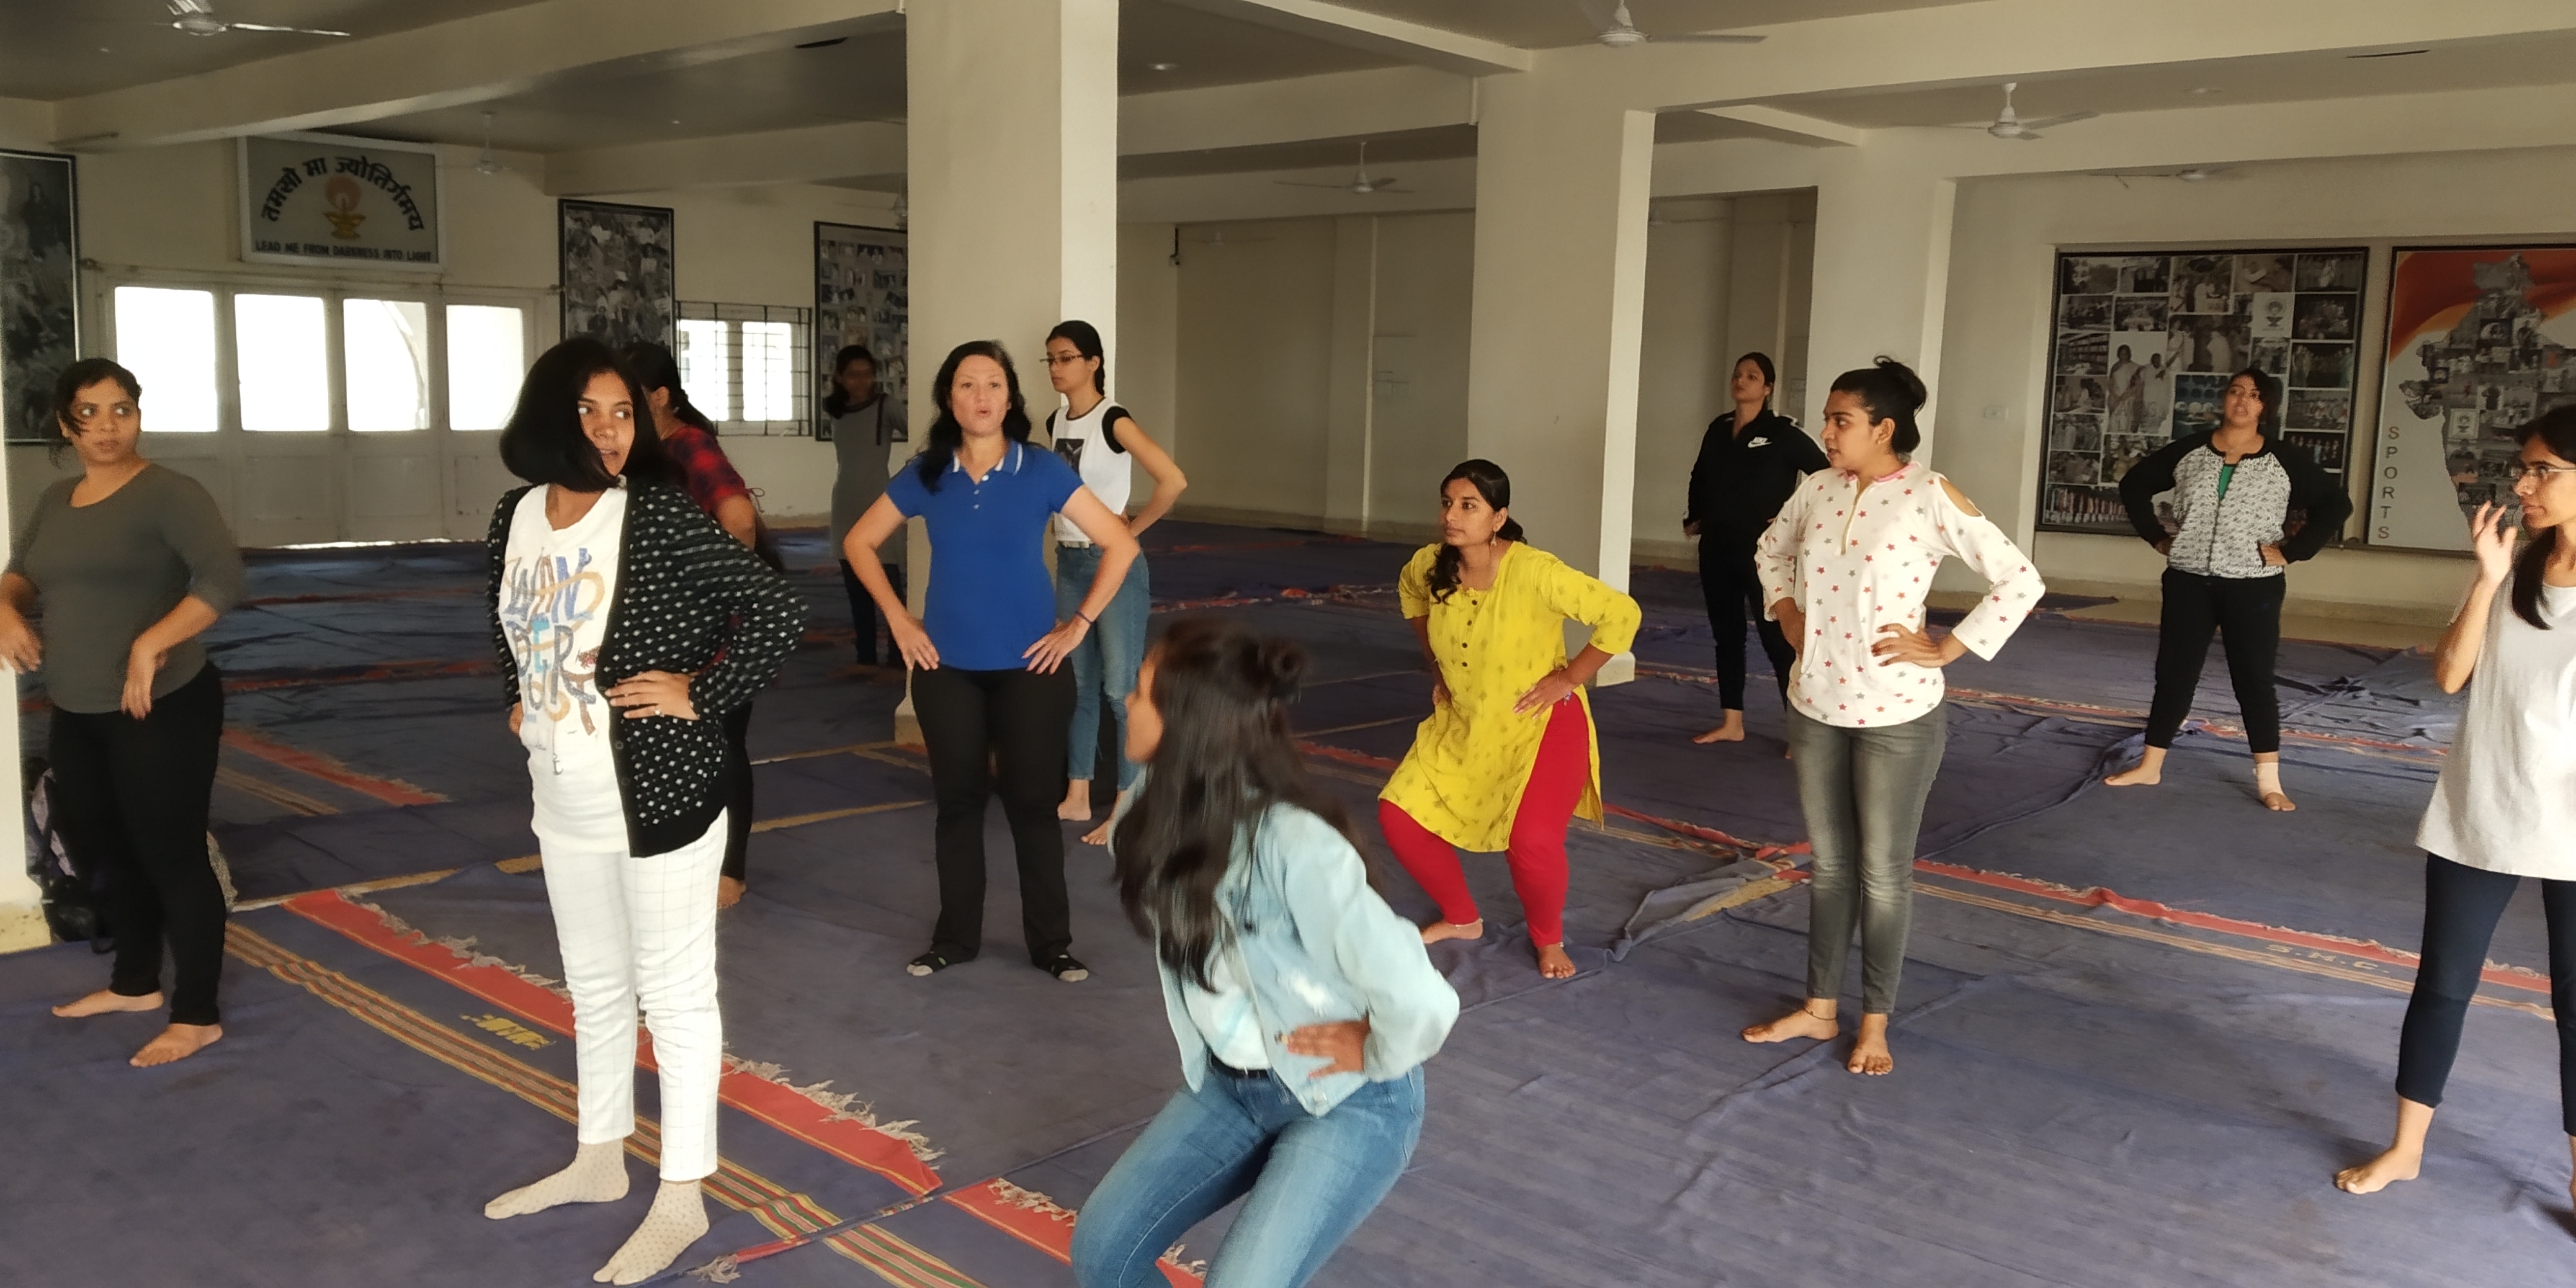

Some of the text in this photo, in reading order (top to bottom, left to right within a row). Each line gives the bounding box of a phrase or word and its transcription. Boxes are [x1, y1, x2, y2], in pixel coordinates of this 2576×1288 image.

[261, 167, 302, 222] तमसो
[303, 157, 327, 177] मा
[255, 240, 432, 262] LEAD ME FROM DARKNESS INTO LIGHT
[2378, 426, 2400, 539] SPORTS
